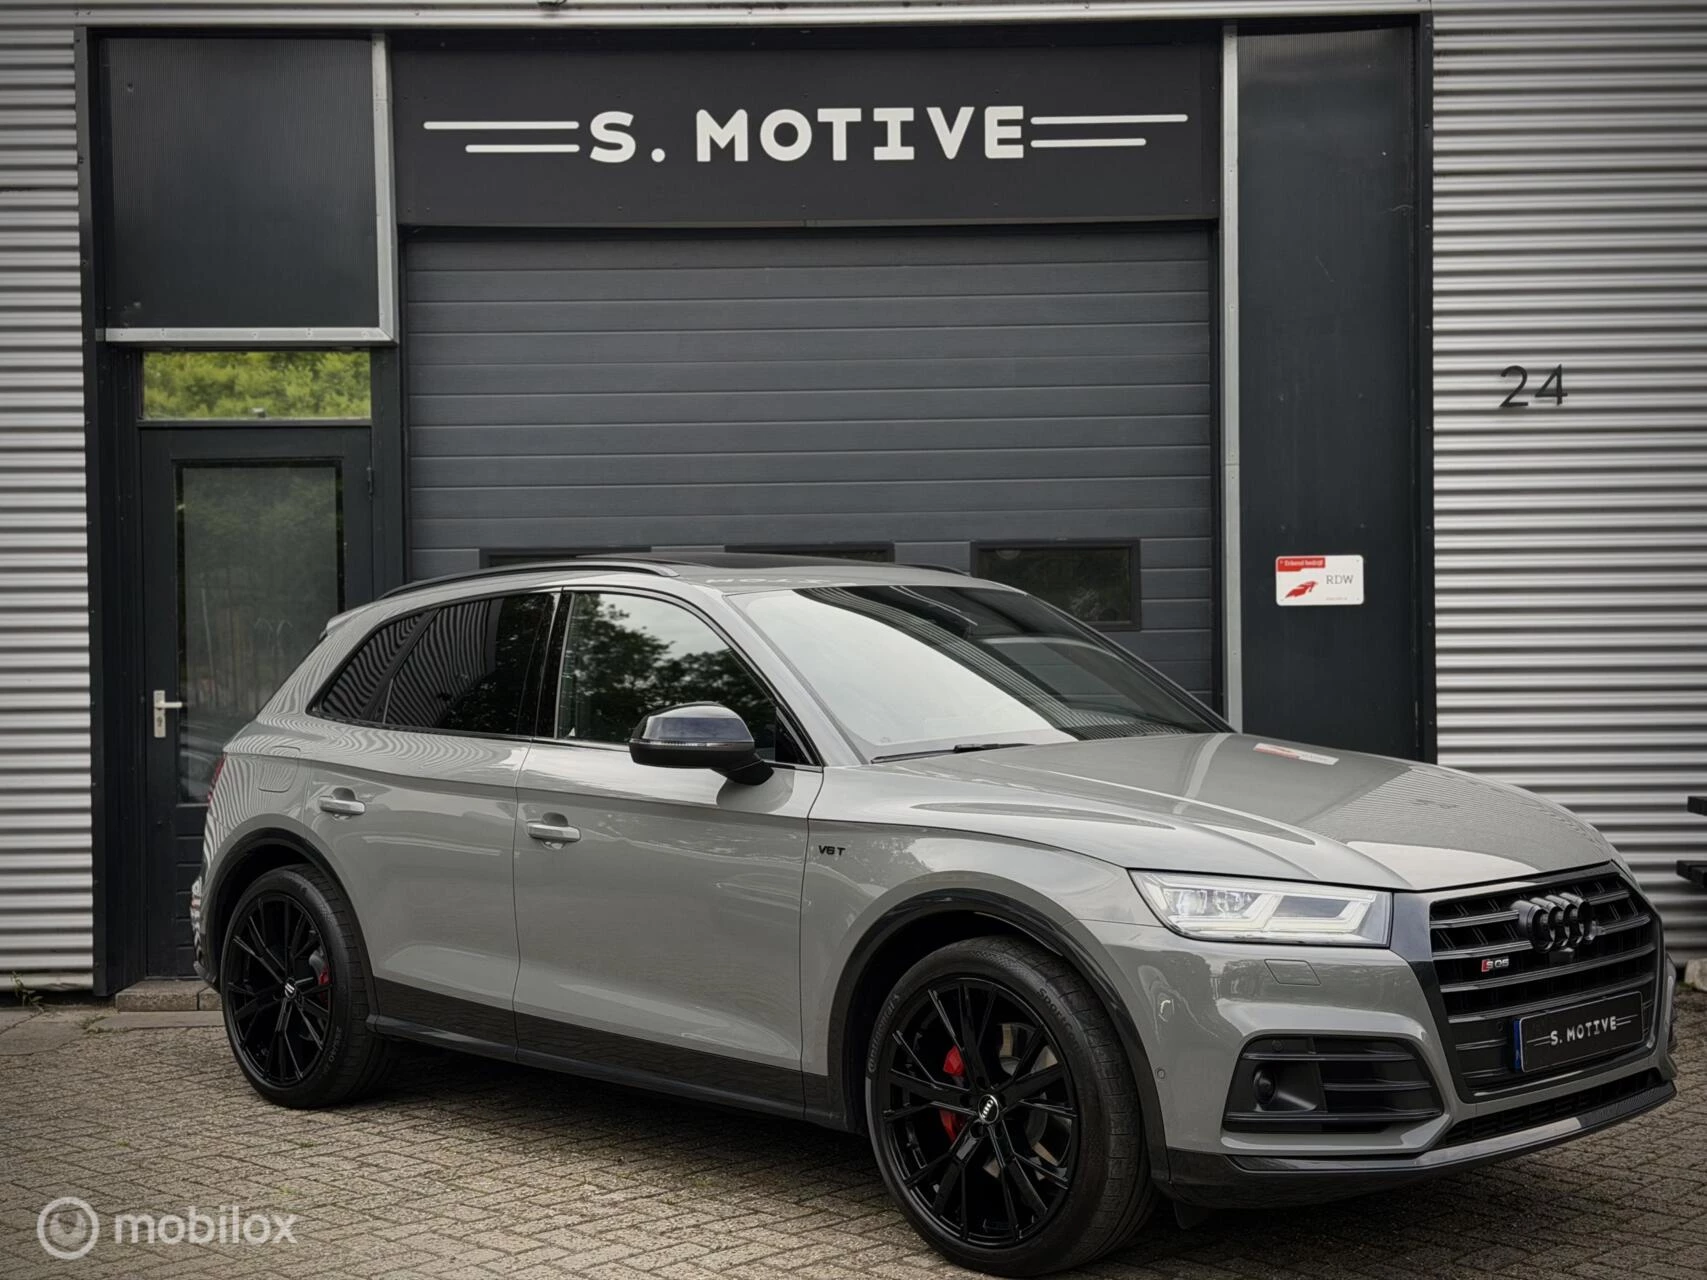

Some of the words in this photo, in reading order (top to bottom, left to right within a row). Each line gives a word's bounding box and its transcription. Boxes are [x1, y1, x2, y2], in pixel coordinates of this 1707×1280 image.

[589, 110, 665, 163] S.
[696, 105, 1024, 162] MOTIVE
[1499, 363, 1568, 408] 24
[1326, 574, 1354, 585] RDW
[1550, 1029, 1563, 1046] S.
[1566, 1015, 1617, 1042] MOTIVE
